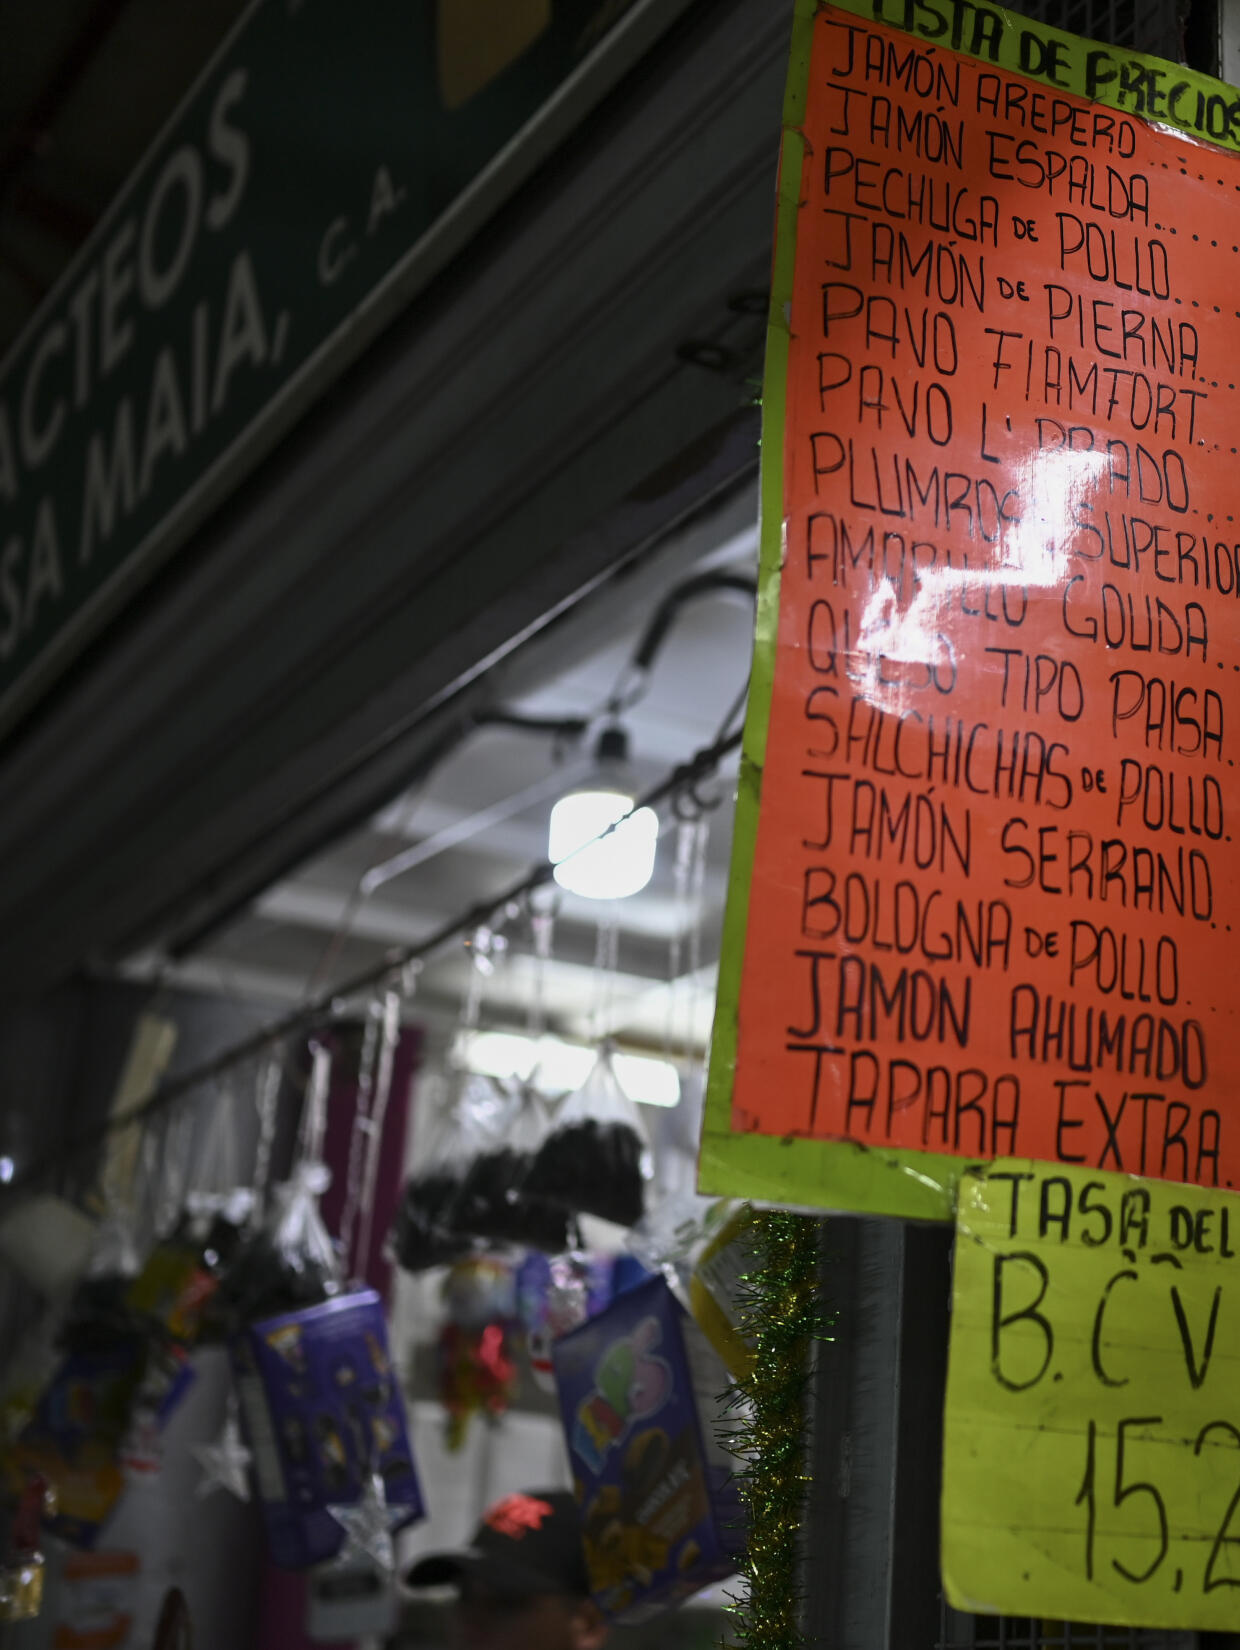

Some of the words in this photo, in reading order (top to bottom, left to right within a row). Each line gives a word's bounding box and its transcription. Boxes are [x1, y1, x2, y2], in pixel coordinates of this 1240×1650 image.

[825, 20, 960, 107] JAMÓN
[976, 73, 1136, 158] AREPERO
[1018, 30, 1072, 87] DE
[823, 147, 1000, 249] PECHUGA
[1056, 211, 1170, 302] POLLO
[825, 82, 964, 170] JAMÓN
[985, 130, 1150, 228] ESPALDA
[0, 68, 250, 500] CTEOS
[823, 209, 985, 313] JAMÓN
[1045, 283, 1201, 381] PIERNA
[817, 351, 953, 446] PAVO
[821, 281, 958, 377] PAVO
[984, 327, 1208, 443] FIAMFORT
[1062, 574, 1210, 668] GOUDA
[804, 686, 1074, 811] SALCHICHAS
[1118, 757, 1224, 841] POLLO
[984, 646, 1084, 723] TIPO
[1108, 669, 1225, 764] PAISA
[802, 769, 971, 878] JAMÓN
[1000, 817, 1213, 921] SERRANO
[801, 867, 1012, 973] BOLOGNA
[1069, 920, 1180, 1007] POLLO
[1010, 984, 1208, 1091] AHUMADO
[786, 1042, 1021, 1158] TAPARA
[1054, 1080, 1221, 1188] EXTRA
[987, 1172, 1152, 1252] TASA
[1171, 1205, 1235, 1258] DEL
